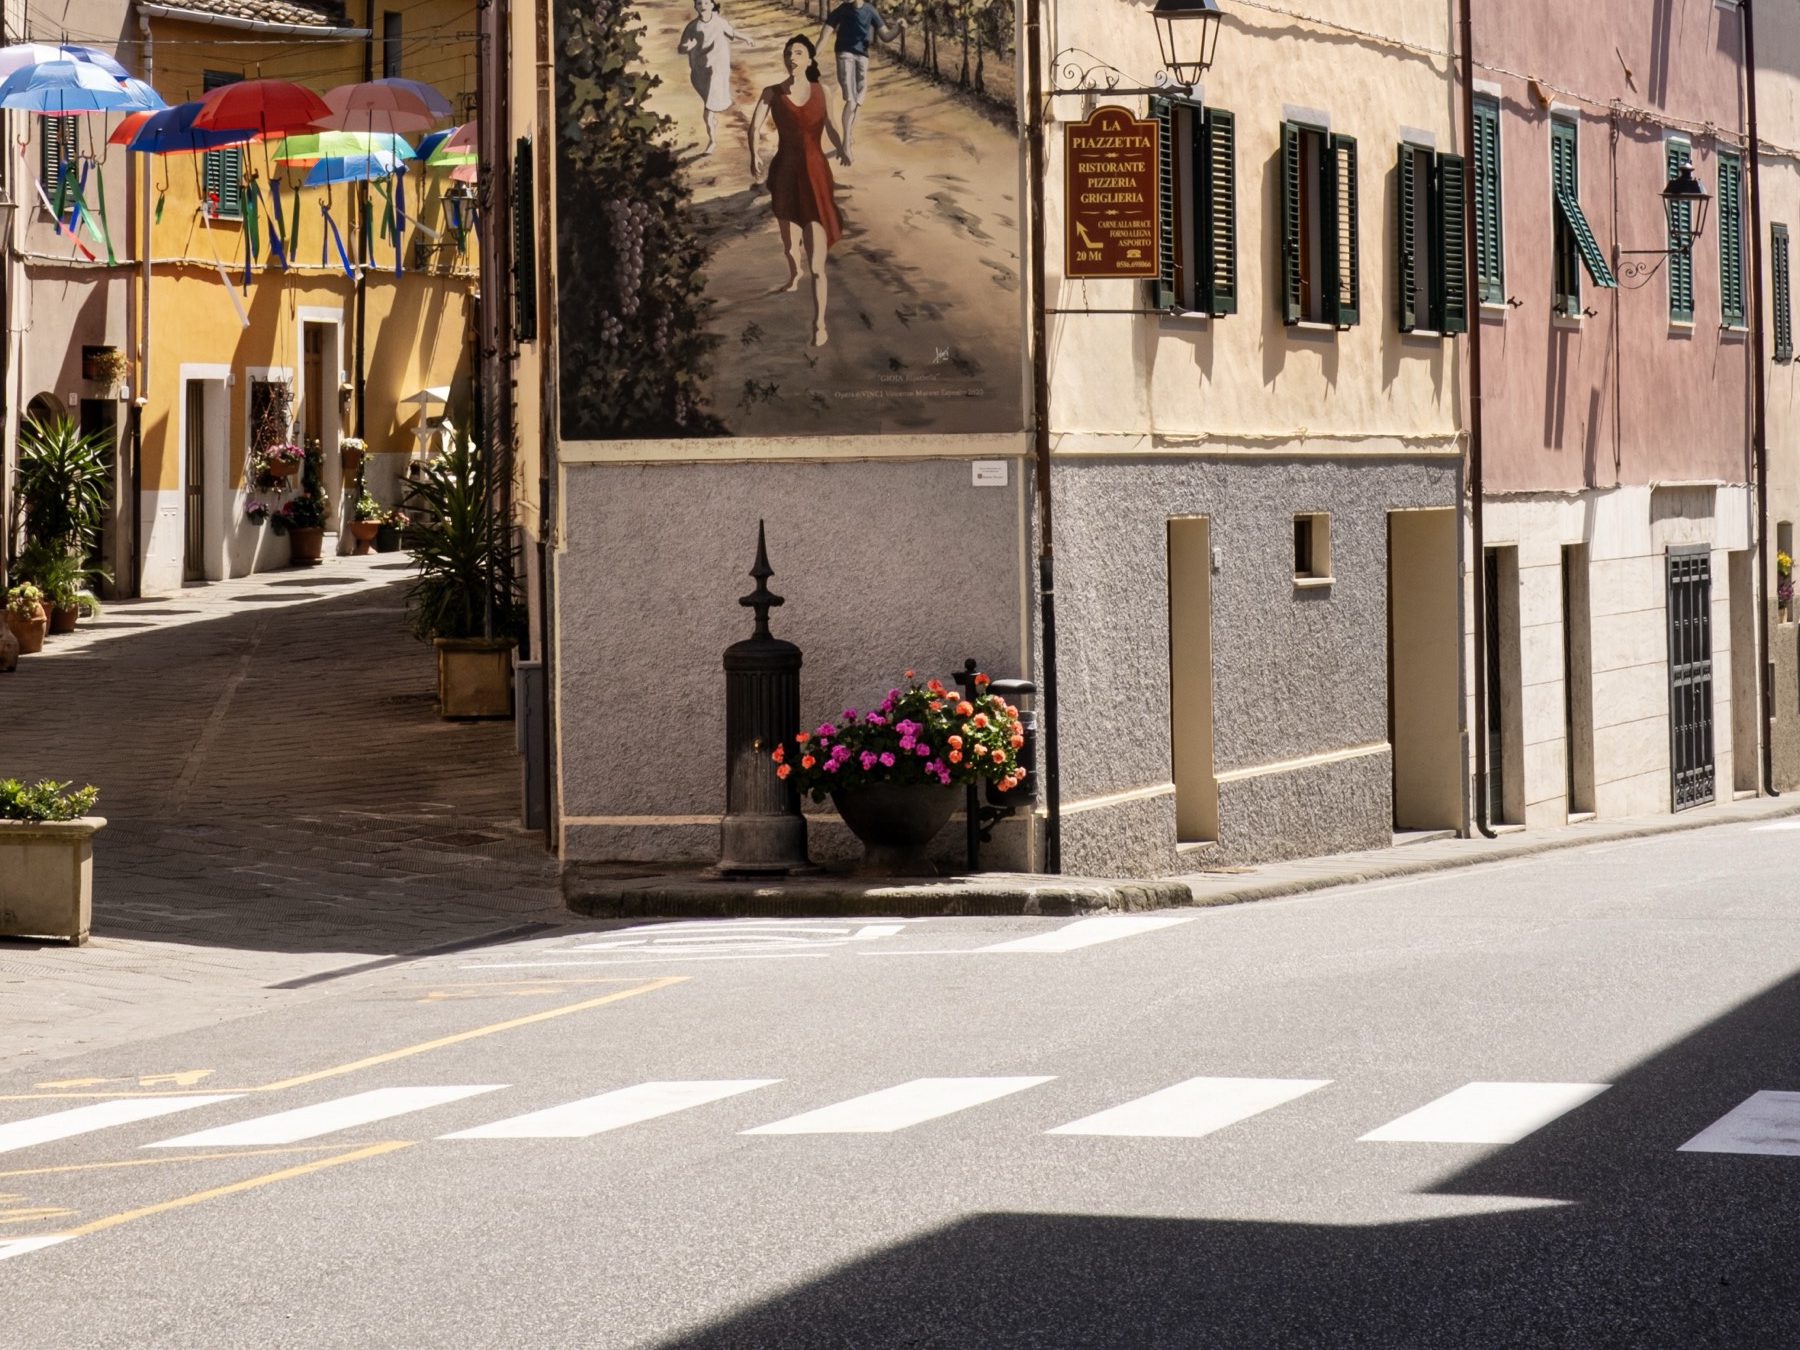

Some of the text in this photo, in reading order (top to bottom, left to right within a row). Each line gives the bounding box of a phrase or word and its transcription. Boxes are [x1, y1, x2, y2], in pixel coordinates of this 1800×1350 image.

[1102, 120, 1121, 131] LA
[1073, 136, 1151, 148] PIAZZETTA
[1078, 162, 1146, 173] RISTORANTE
[1087, 177, 1137, 188] PIZZERIA
[1080, 192, 1144, 203] GRIGLIERIA
[1097, 220, 1151, 229] CARNE ALLA BRACE
[1110, 229, 1128, 238] FORNO
[1133, 229, 1151, 238] LEGNA
[1118, 239, 1152, 247] ASPORTO
[1076, 251, 1102, 261] 20 Mt
